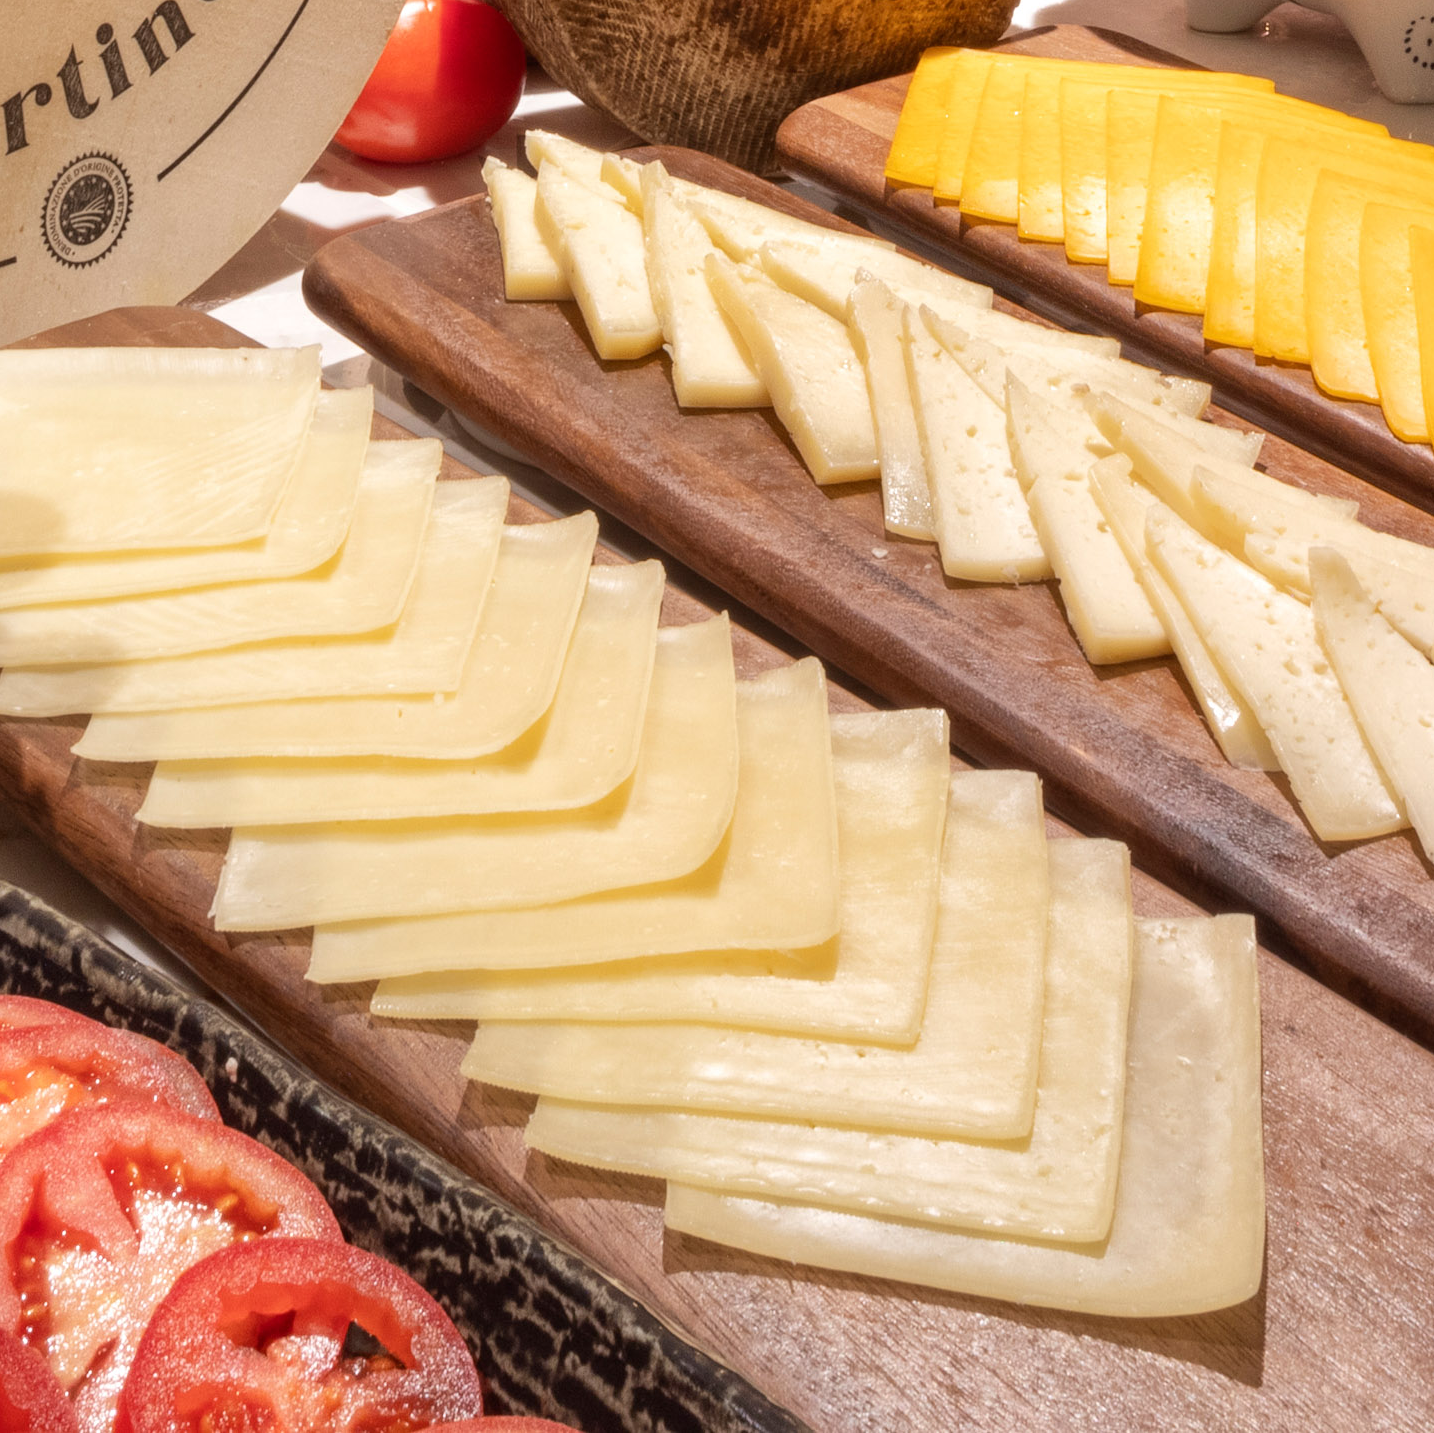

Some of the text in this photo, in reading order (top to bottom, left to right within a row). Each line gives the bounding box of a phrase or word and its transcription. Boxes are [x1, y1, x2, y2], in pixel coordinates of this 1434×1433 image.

[49, 162, 125, 256] DENOMINAZIONE D'ORIGINE PROTETTA
